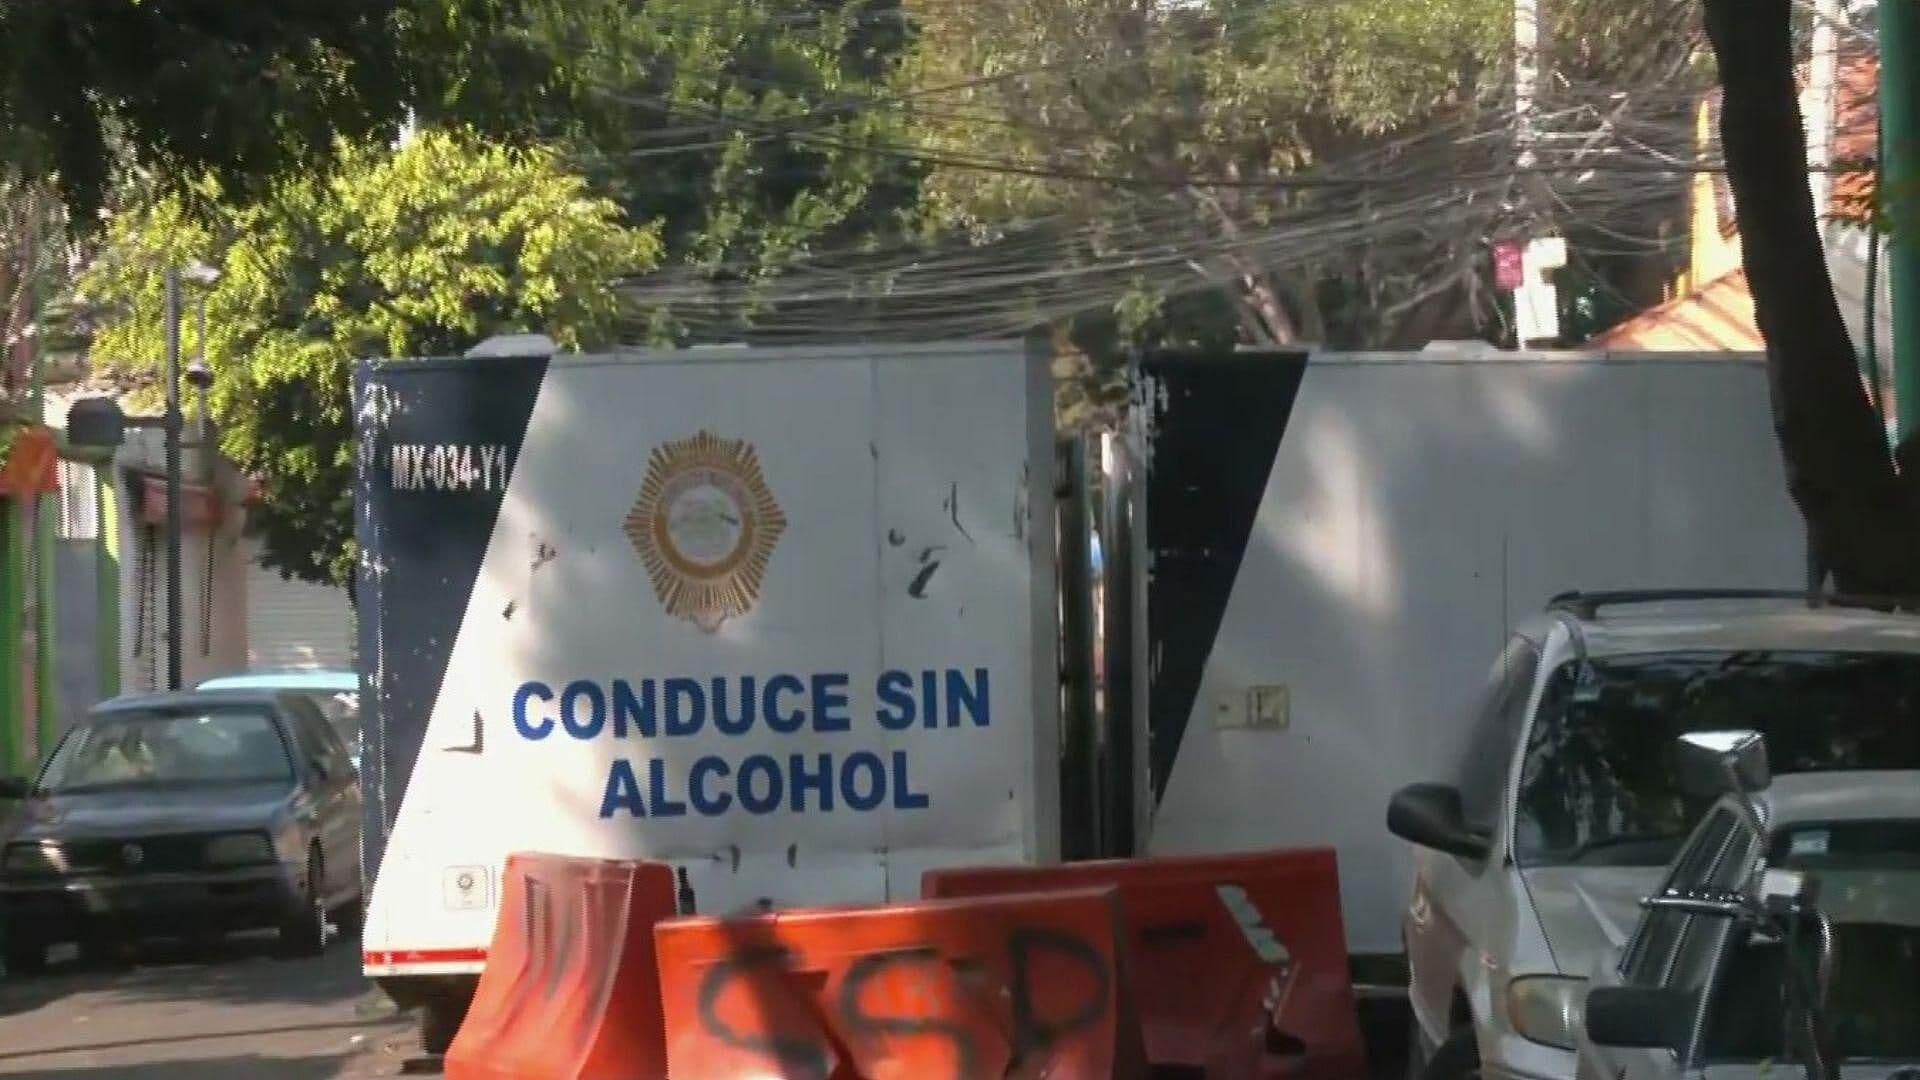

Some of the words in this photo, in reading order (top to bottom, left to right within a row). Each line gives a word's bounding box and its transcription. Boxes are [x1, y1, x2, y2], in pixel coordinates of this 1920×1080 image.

[390, 443, 507, 491] MX-034-Y1
[512, 673, 851, 741] CONDUCE
[875, 668, 991, 731] SIN
[599, 750, 930, 819] ALCOHOL
[698, 926, 1113, 1080] SSP
